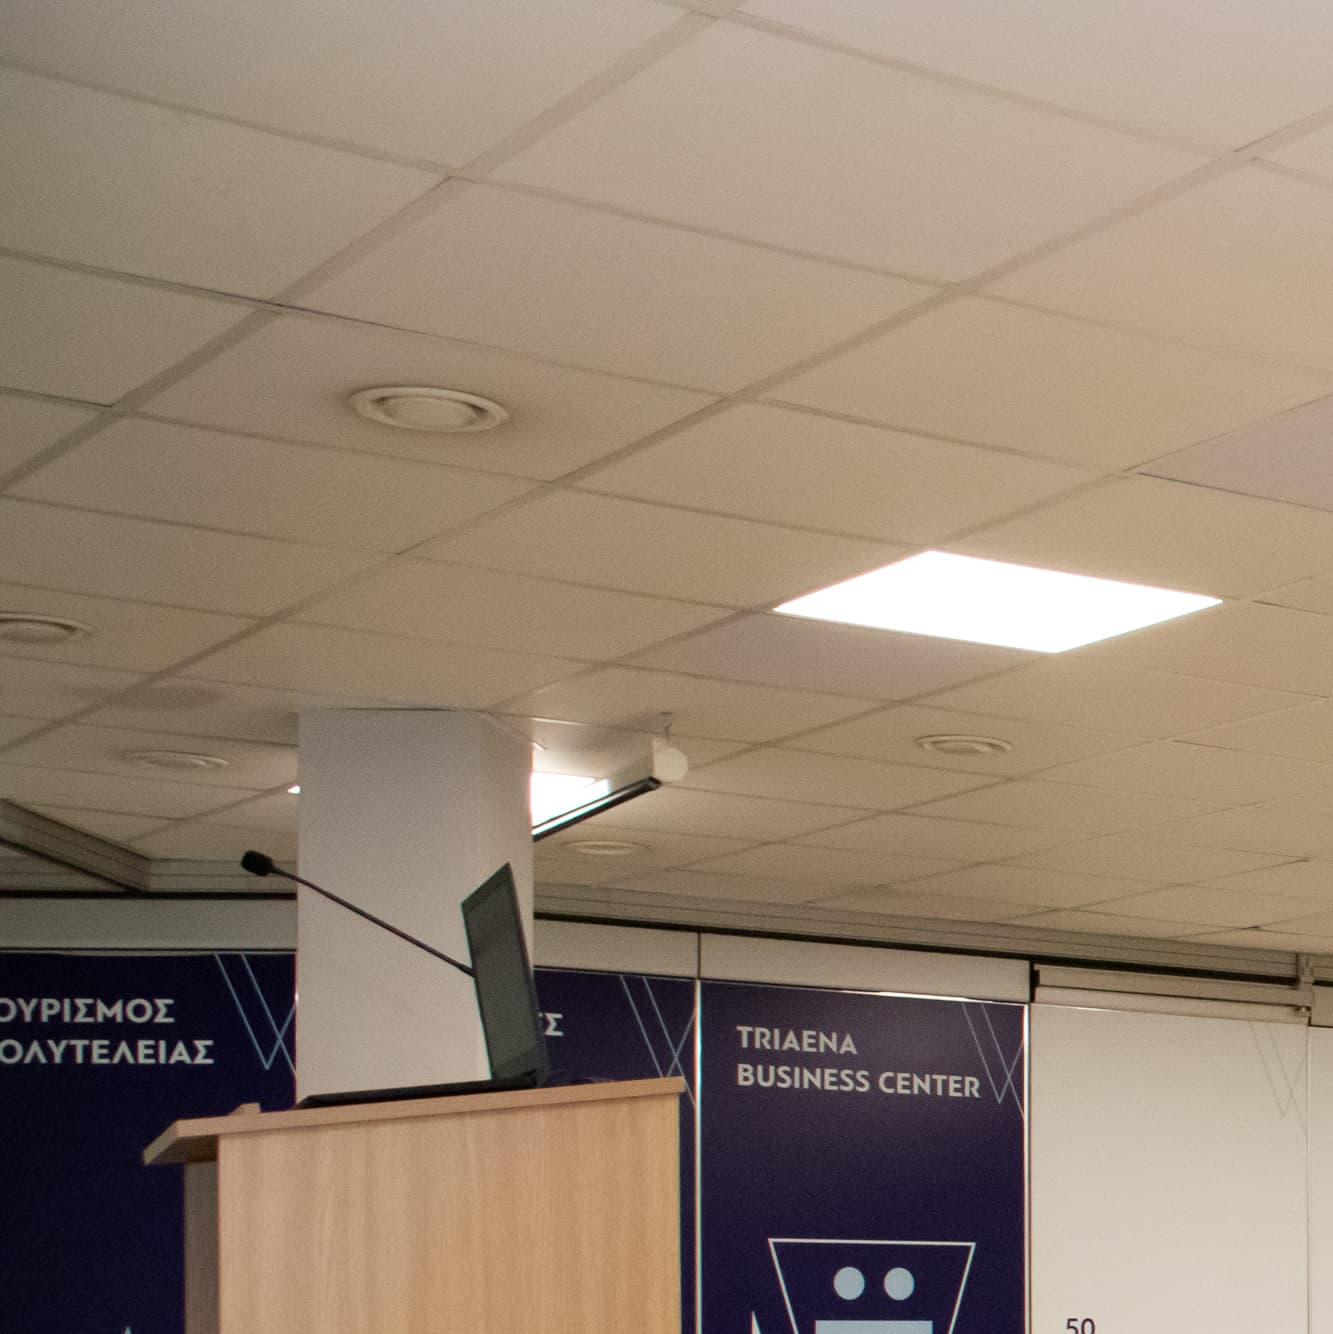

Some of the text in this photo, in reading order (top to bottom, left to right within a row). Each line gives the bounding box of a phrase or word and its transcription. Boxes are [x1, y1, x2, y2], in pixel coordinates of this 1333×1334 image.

[0, 1039, 214, 1064] ΟΛΥΤΕΛΕΙΑΣ
[736, 1025, 858, 1055] TRIAENA
[737, 1063, 980, 1098] BUSINESS CENTER
